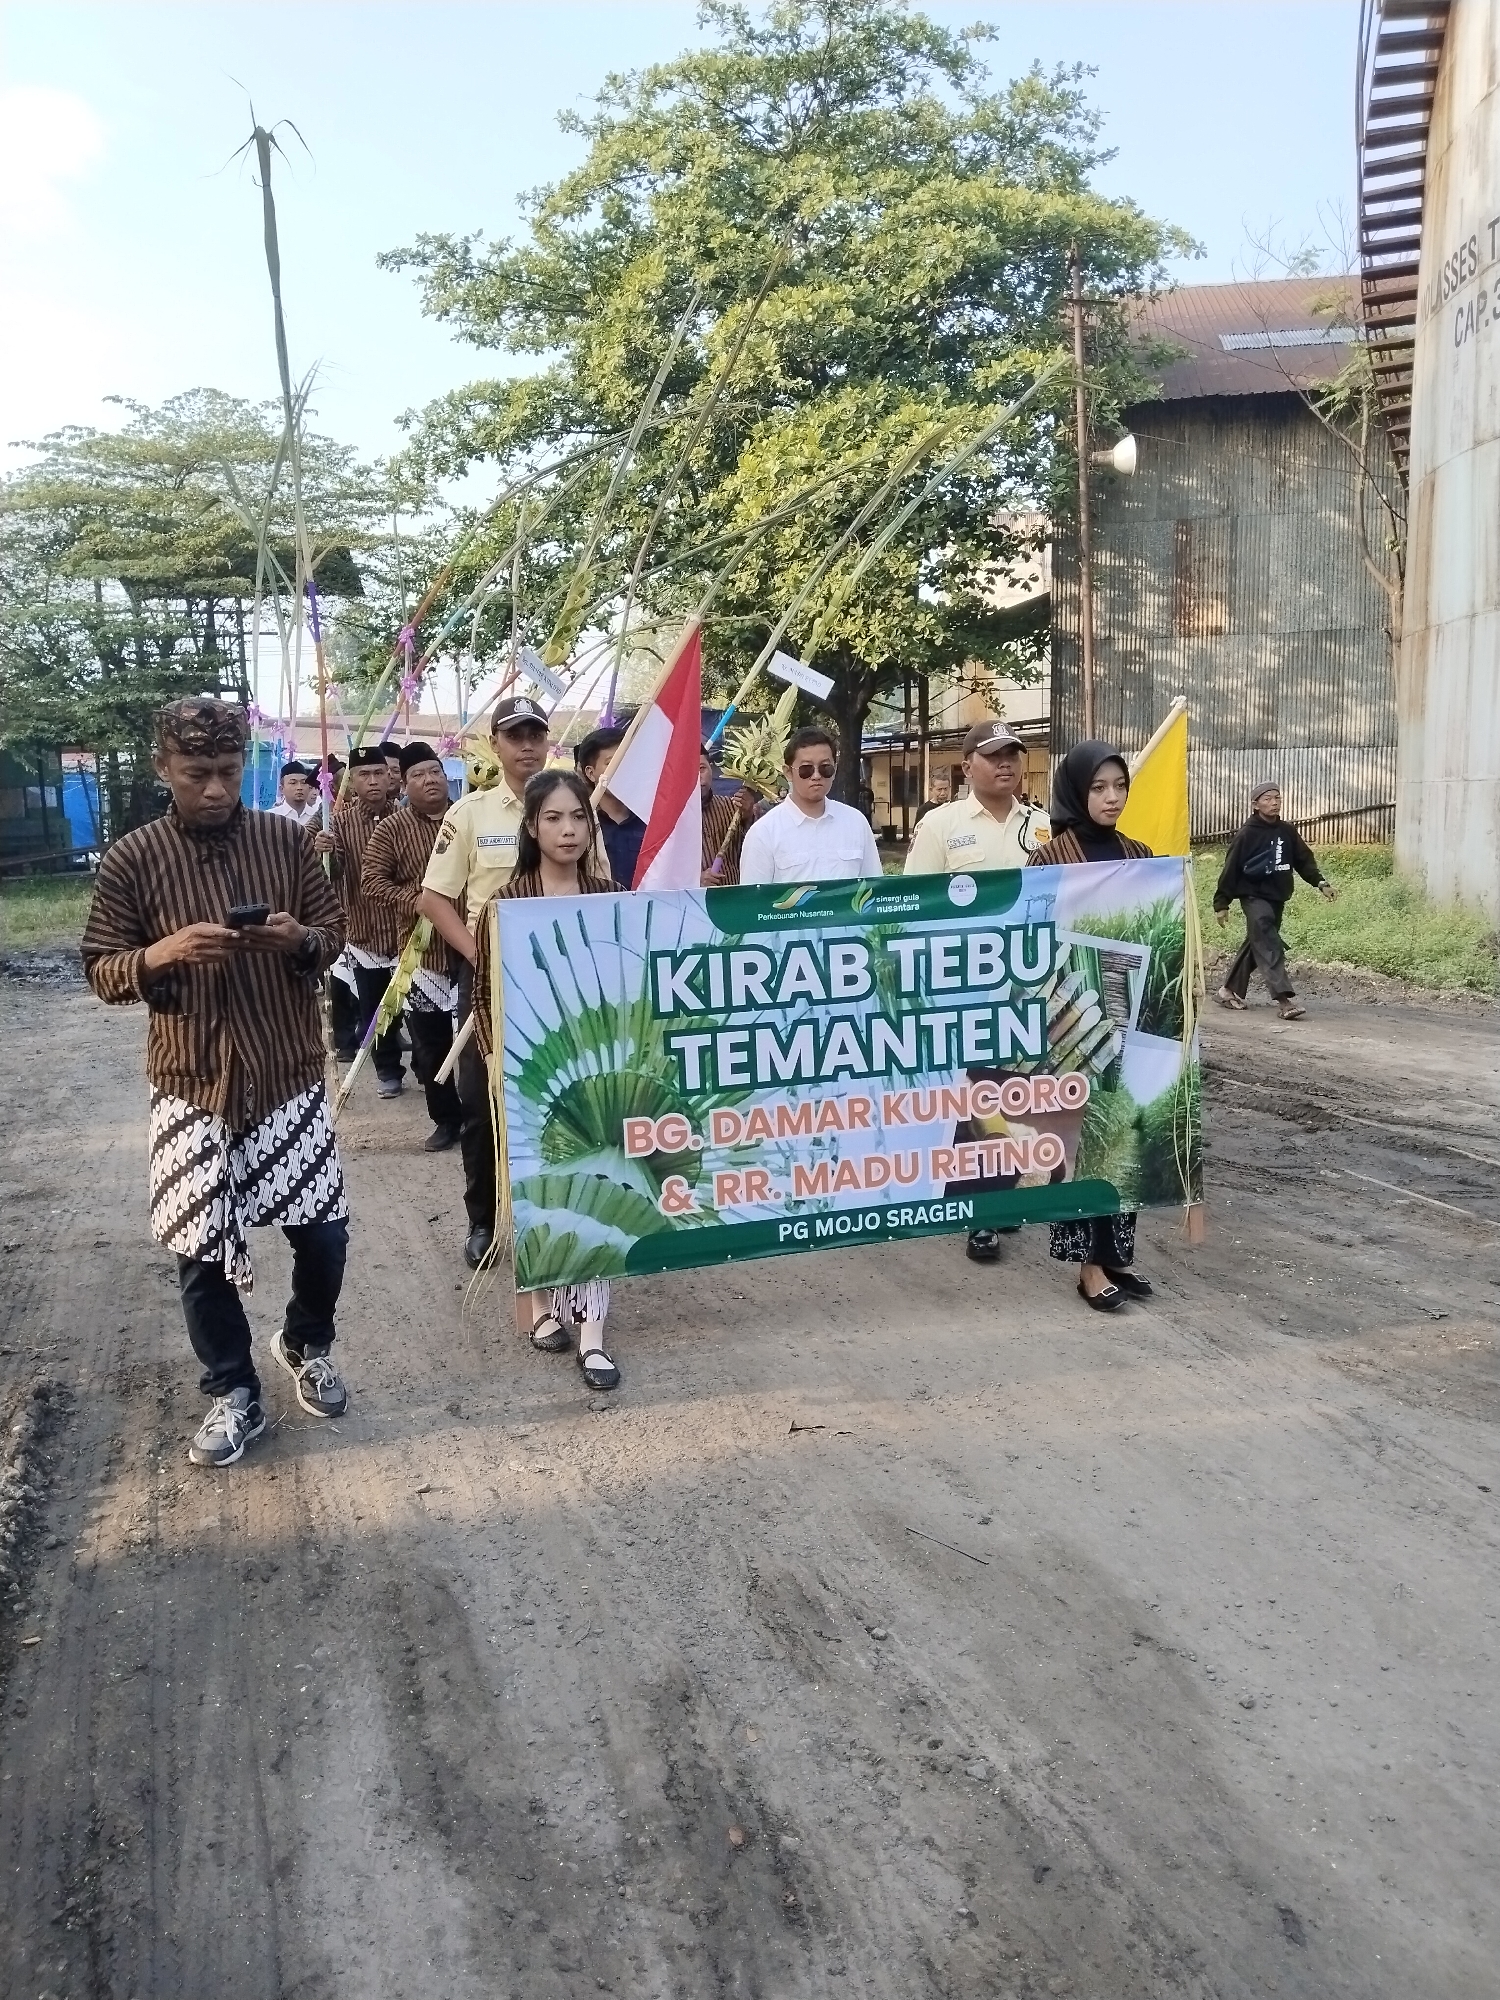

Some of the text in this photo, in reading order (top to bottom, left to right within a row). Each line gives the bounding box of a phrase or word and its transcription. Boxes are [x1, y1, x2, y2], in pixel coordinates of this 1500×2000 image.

[757, 909, 834, 921] Perkebunan Nusantara
[875, 893, 920, 904] sinergi gula
[876, 902, 920, 913] nusantara
[654, 925, 1052, 1015] KIRAB TEBU
[668, 1001, 1044, 1092] TEMANTEN
[624, 1073, 1089, 1156] BG. DAMAR KUNCORO
[660, 1135, 1063, 1214] & RR. MADU RETNO
[778, 1200, 974, 1242] PG MOJO SRAGEN
